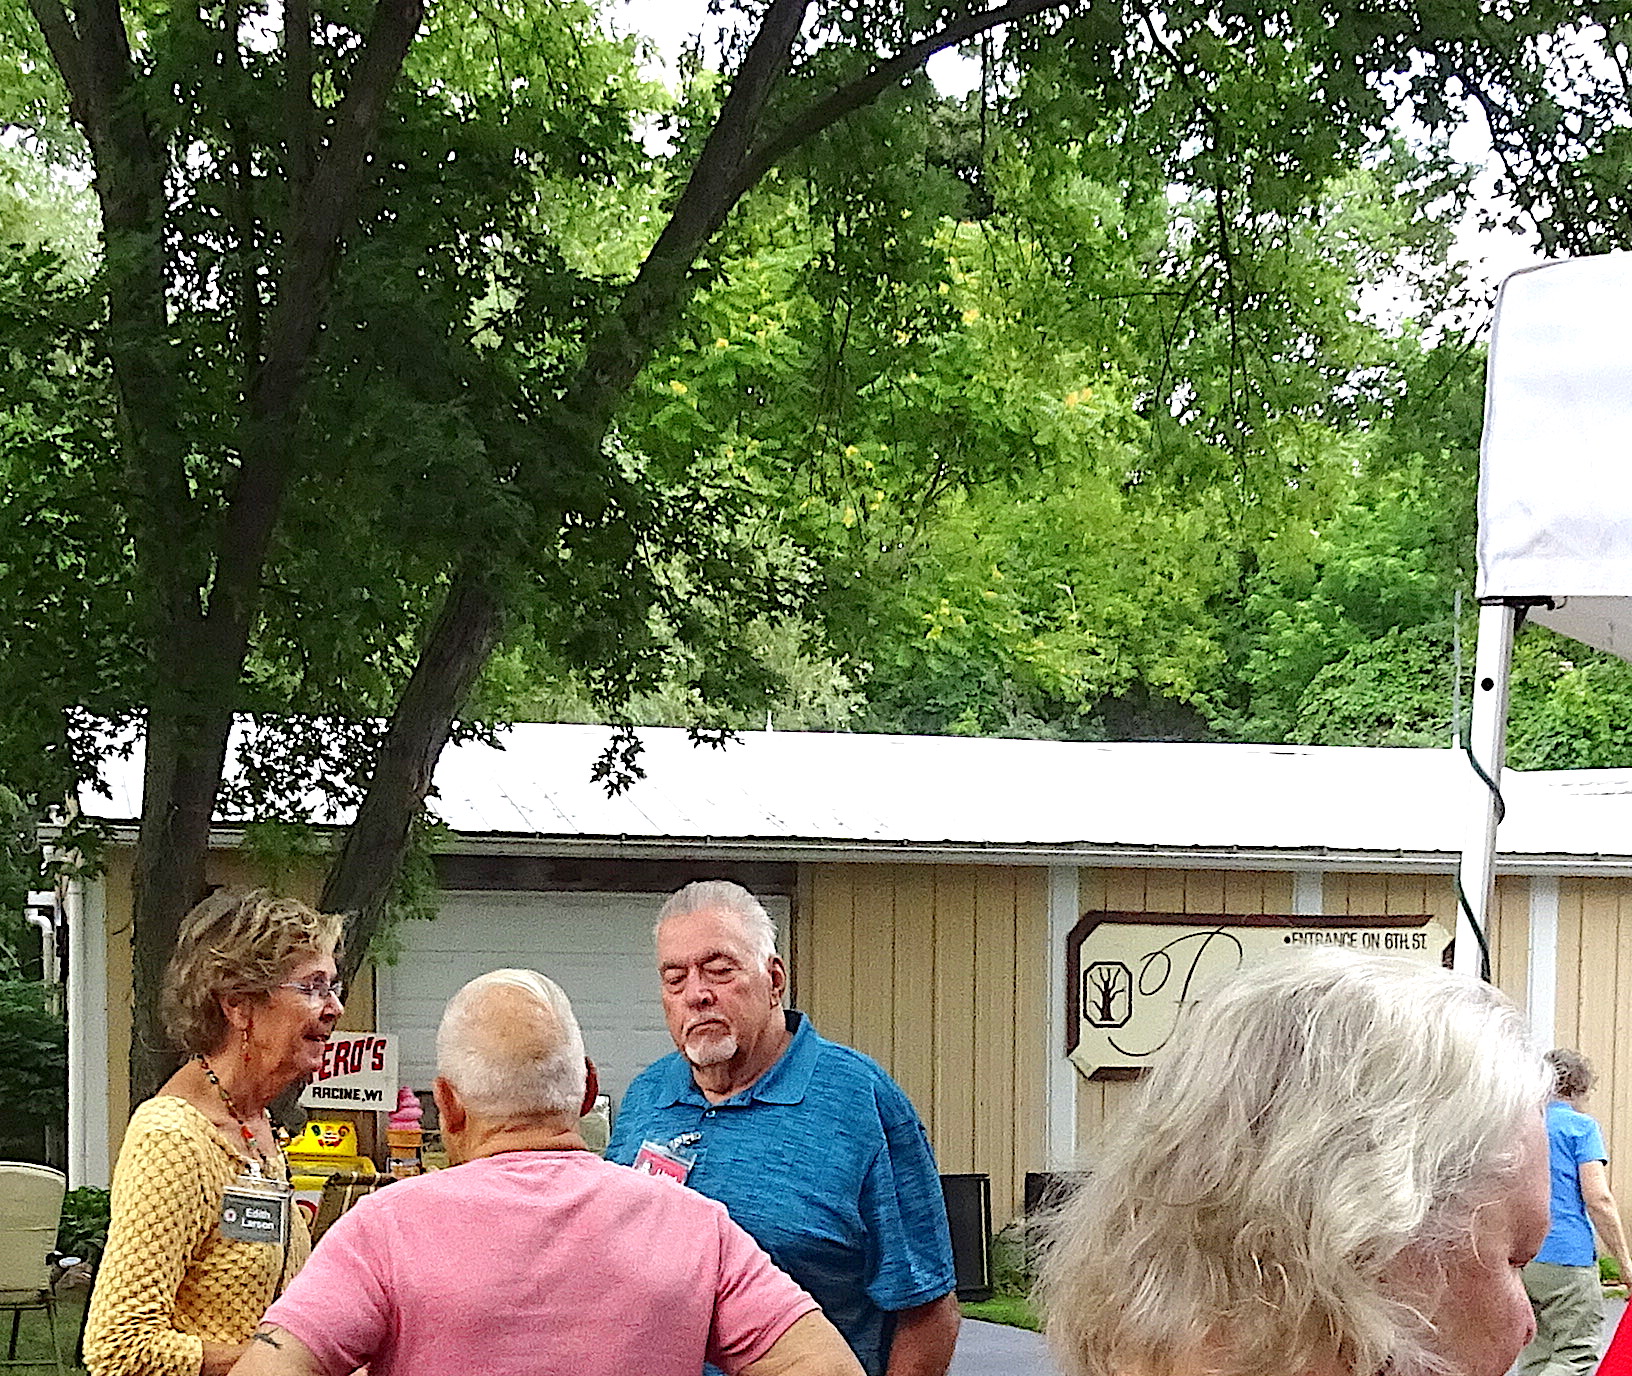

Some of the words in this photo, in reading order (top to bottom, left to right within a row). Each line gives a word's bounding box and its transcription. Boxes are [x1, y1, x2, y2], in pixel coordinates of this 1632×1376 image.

[1292, 932, 1357, 948] ENTRANCE
[1362, 933, 1379, 949] ON
[308, 1037, 387, 1084] ERO'S
[245, 1207, 271, 1220] Edith
[241, 1217, 275, 1231] Larson
